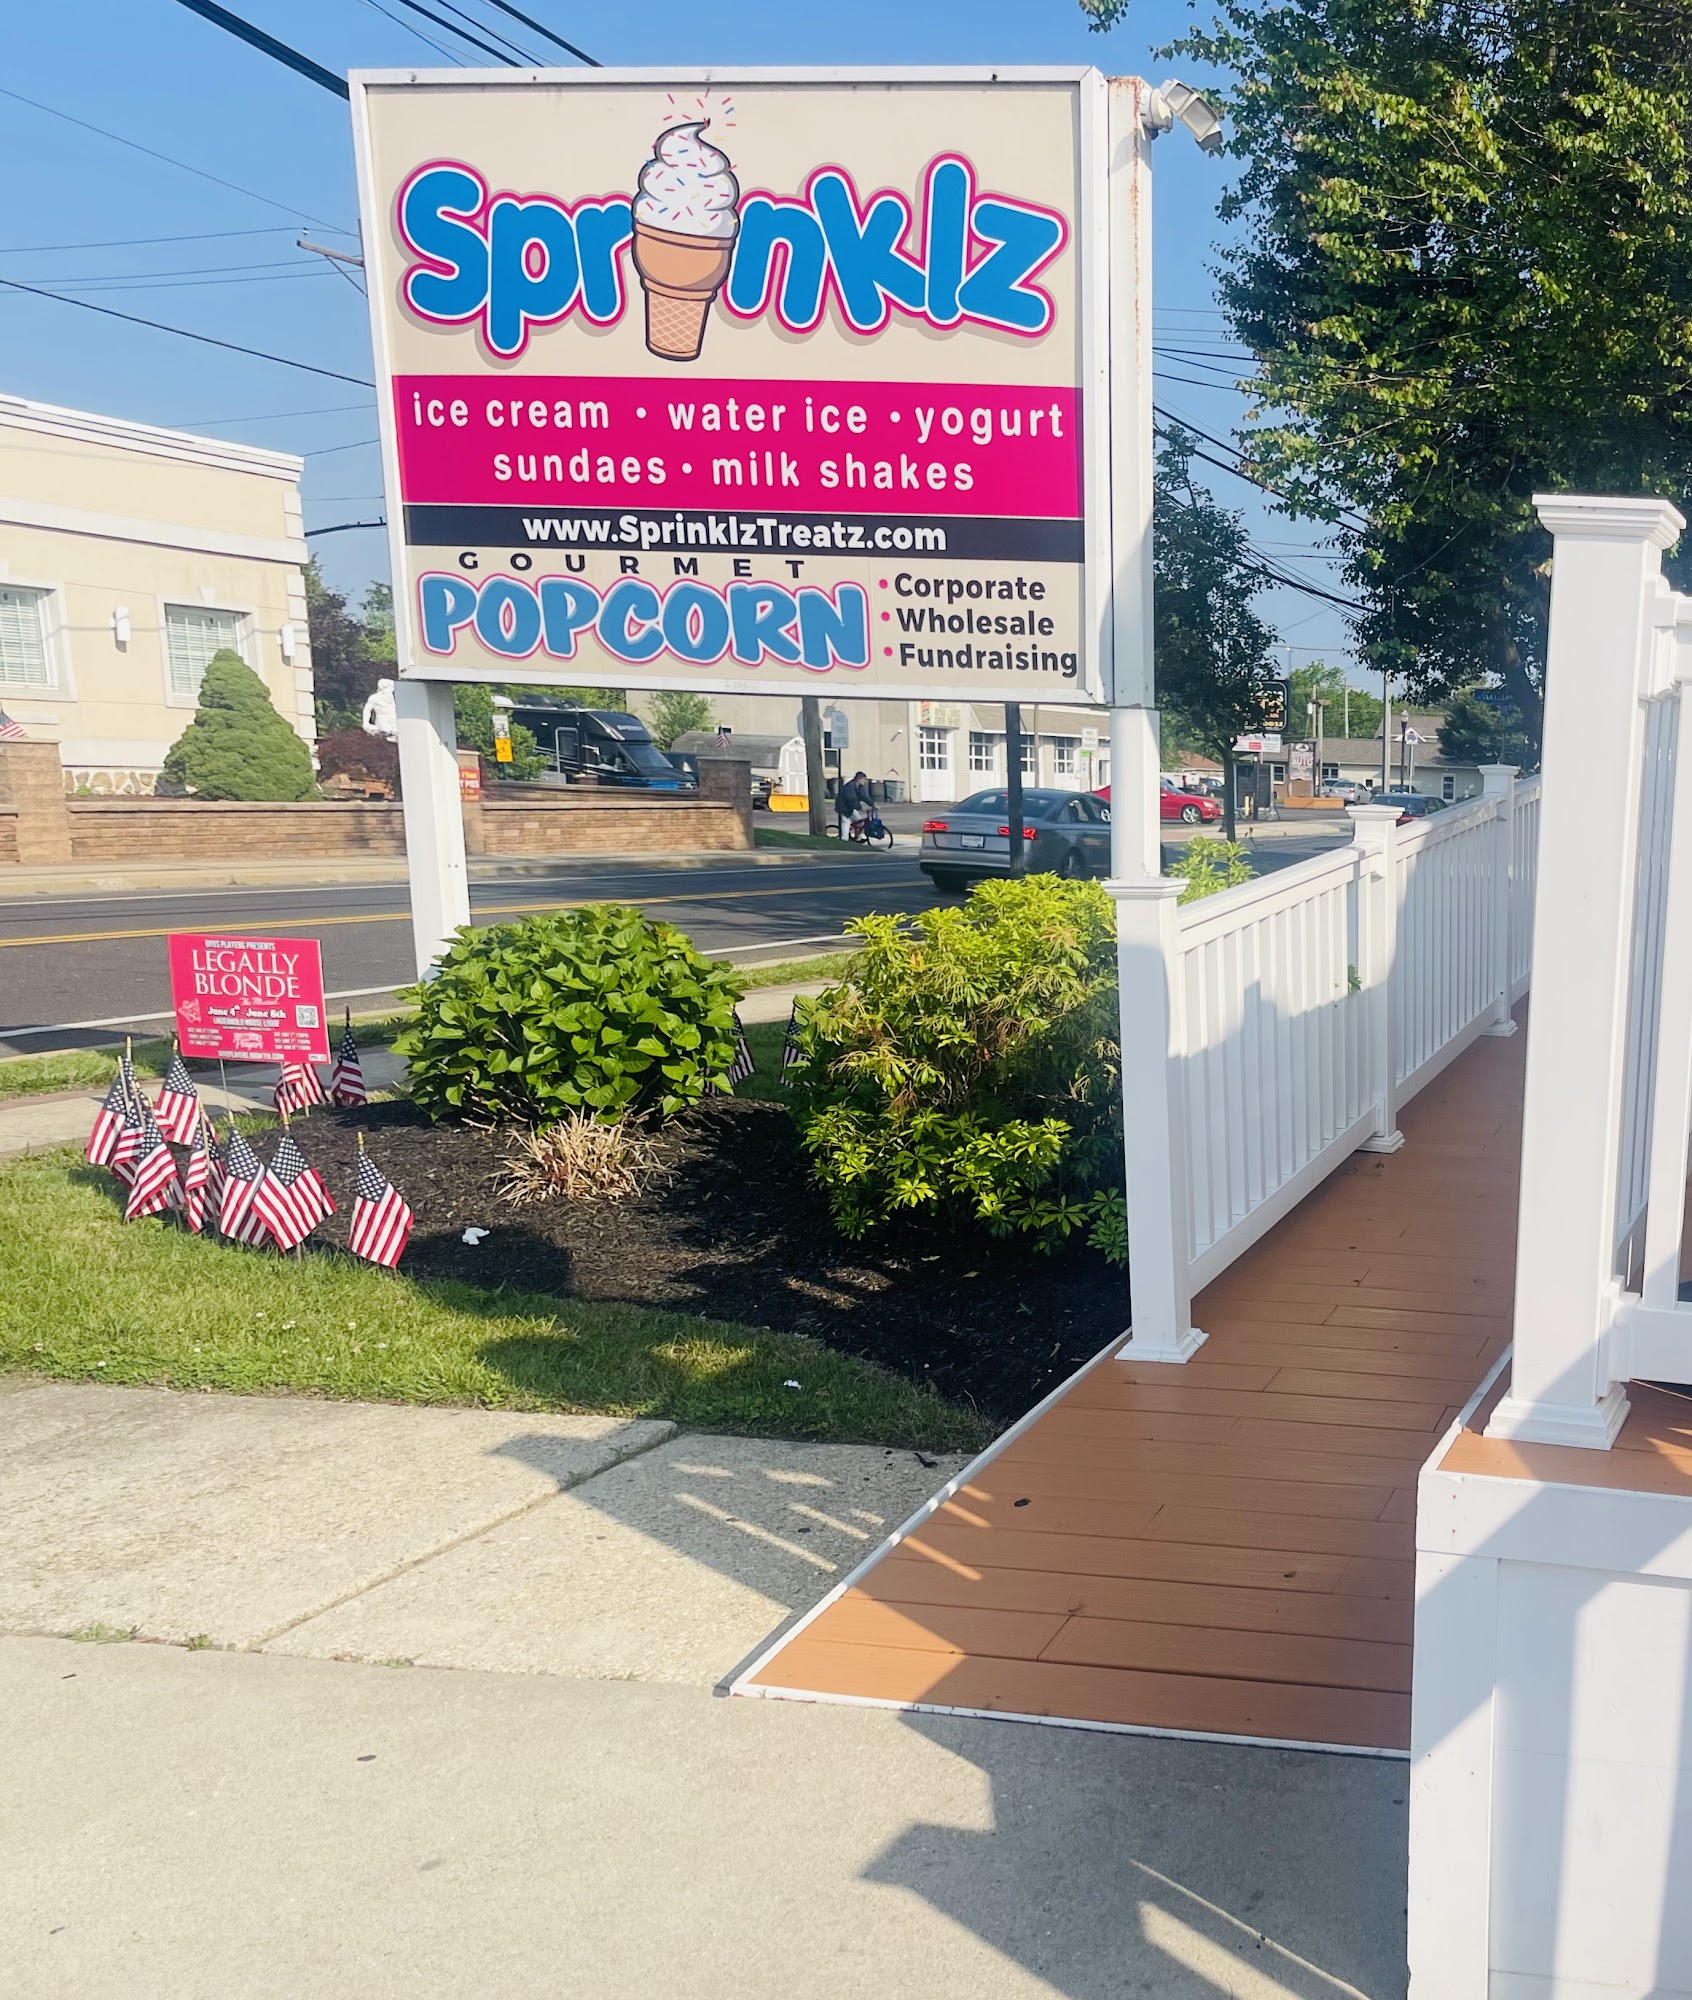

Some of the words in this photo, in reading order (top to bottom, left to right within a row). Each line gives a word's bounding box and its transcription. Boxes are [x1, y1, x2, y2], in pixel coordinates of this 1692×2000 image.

[414, 393, 468, 427] ice
[487, 399, 609, 429] cream
[668, 398, 785, 431] water
[806, 397, 867, 433] ice
[916, 404, 1063, 444] yogurt
[494, 448, 666, 484] sundaes
[712, 452, 800, 487] milk
[820, 453, 974, 491] shakes
[522, 515, 947, 551] www.SprinklzTreatz.com
[459, 550, 805, 579] GOURMET
[895, 573, 1046, 604] Corporate
[418, 572, 871, 673] POPCORN
[897, 607, 1054, 636] Wholesale
[900, 643, 1078, 678] Fundraising
[1292, 757, 1313, 766] AUTO
[192, 949, 299, 975] LEGALLY
[194, 973, 301, 998] BLONDE
[207, 1006, 228, 1016] June
[246, 1008, 269, 1018] June
